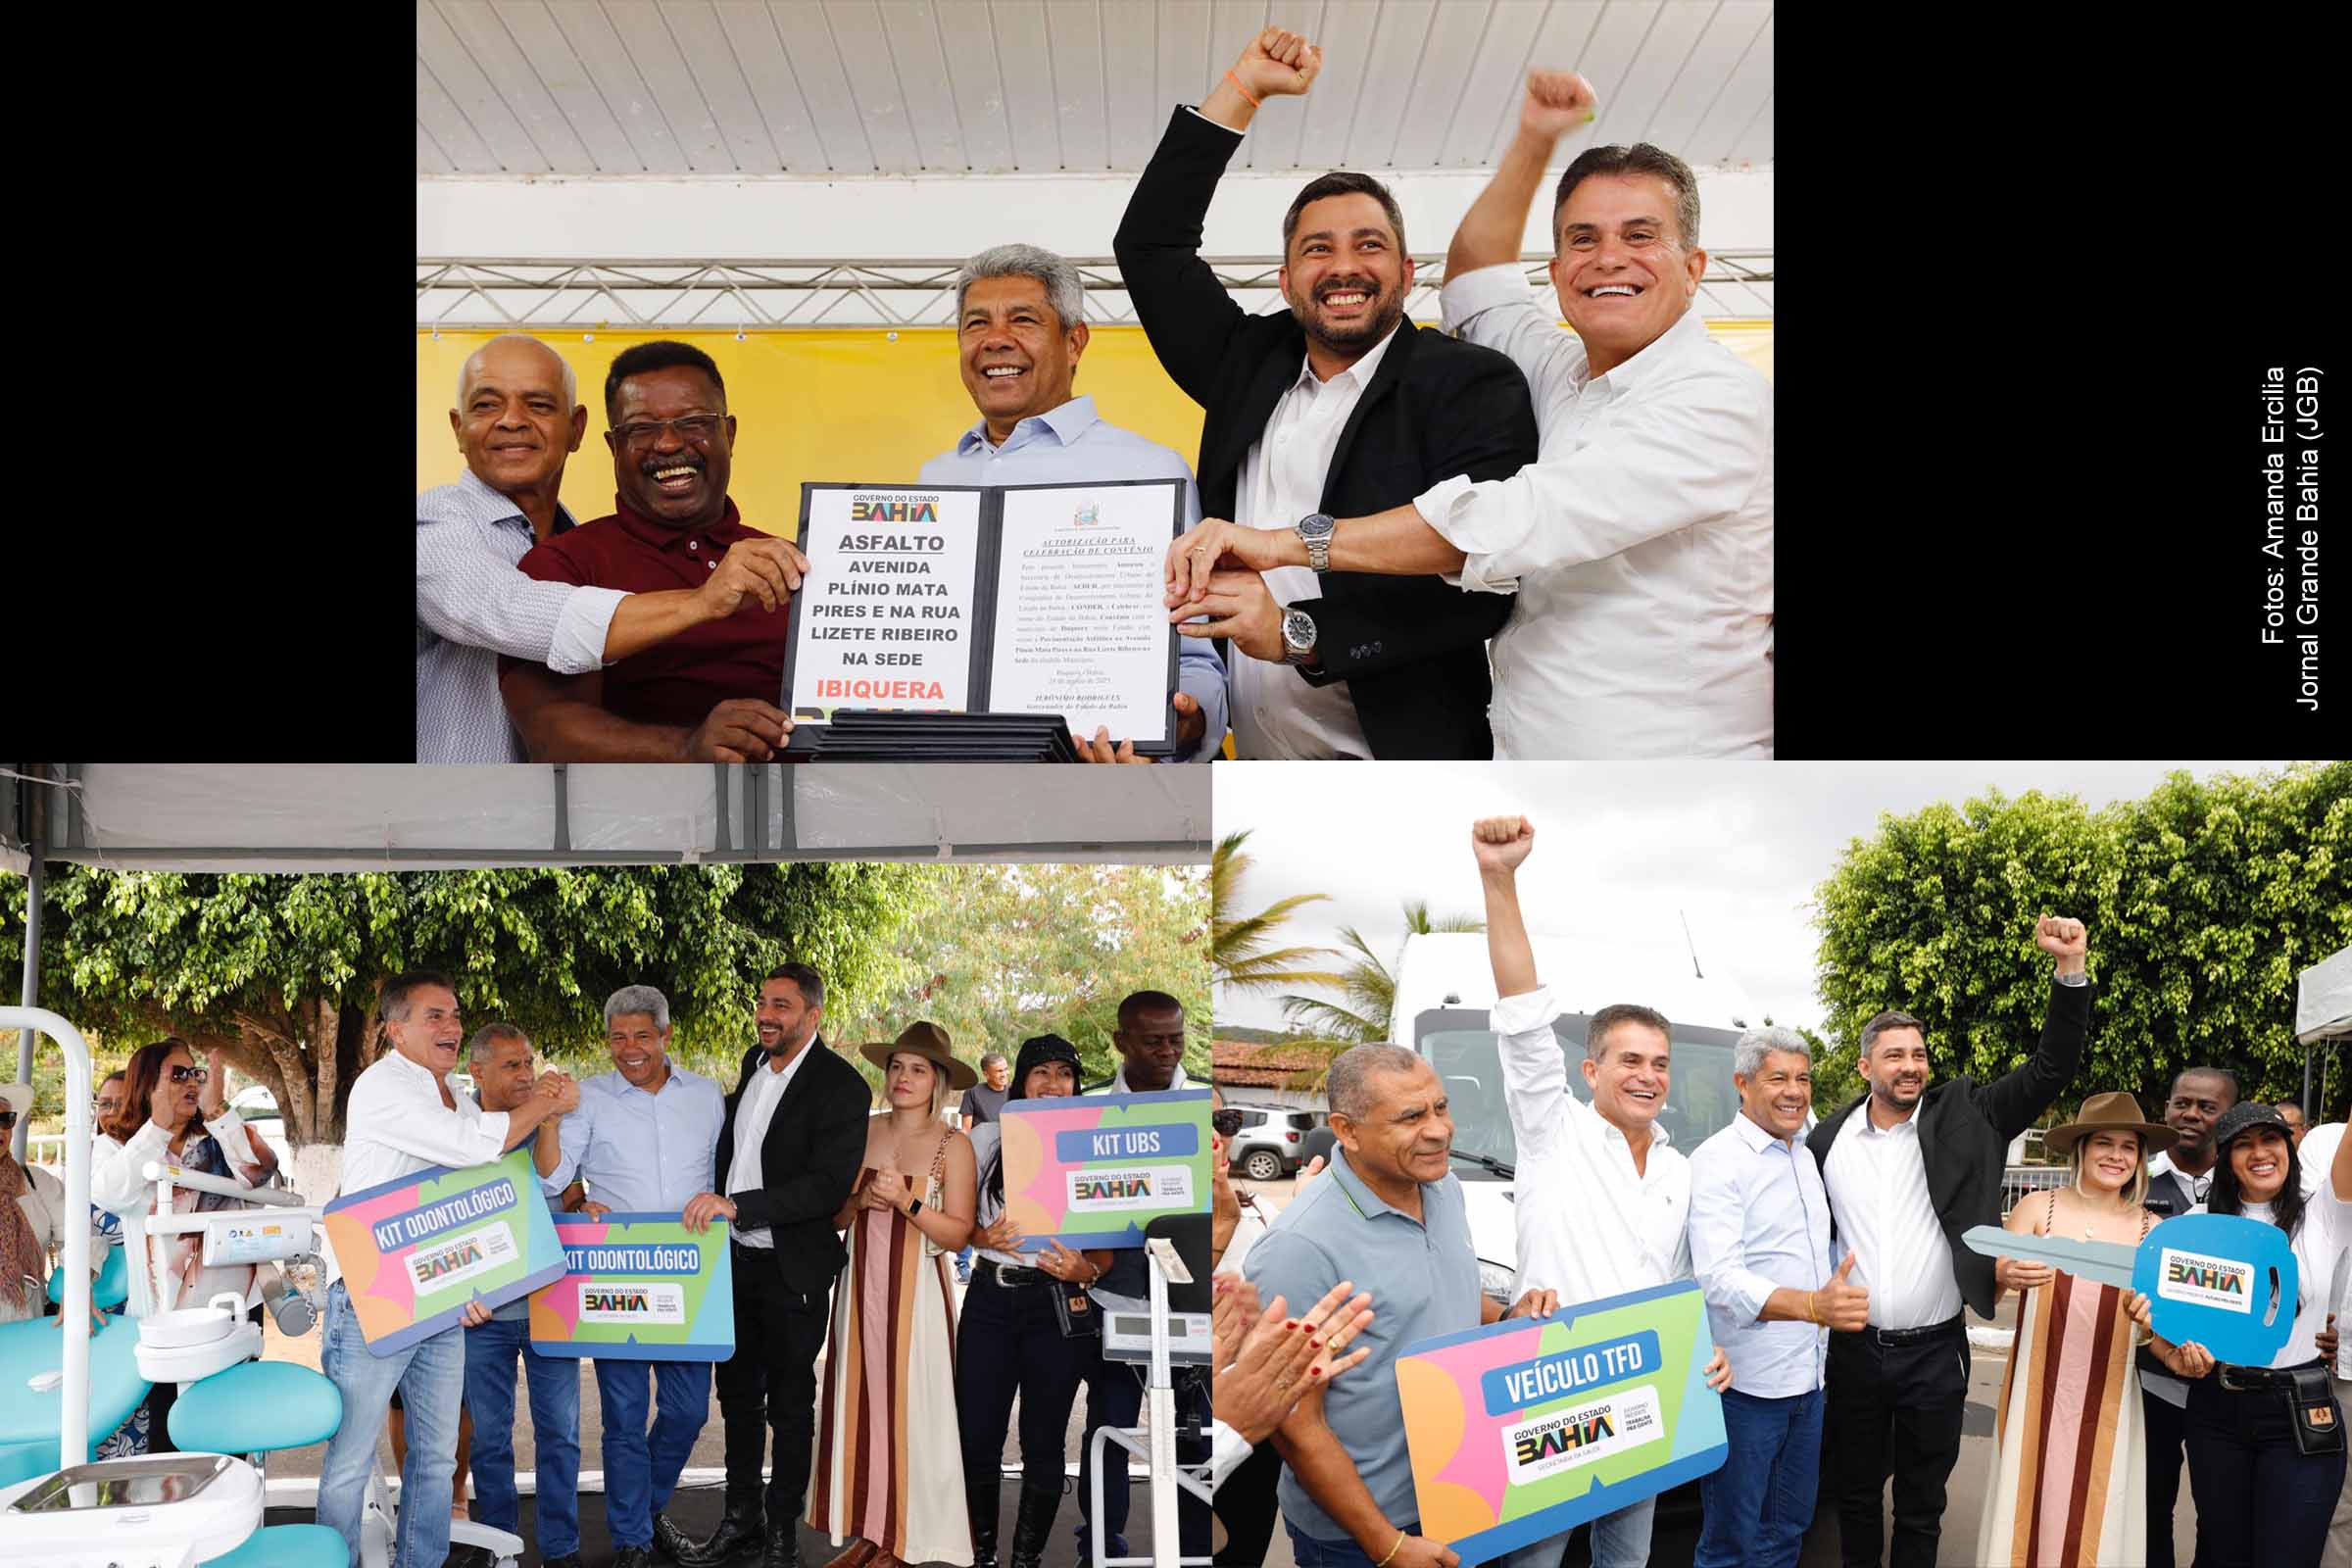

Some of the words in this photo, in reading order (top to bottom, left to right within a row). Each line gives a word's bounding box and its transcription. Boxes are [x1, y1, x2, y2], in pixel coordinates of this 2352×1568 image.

[853, 494, 893, 503] GOVERNO
[895, 494, 907, 503] DO
[839, 534, 945, 551] ASFALTO
[849, 561, 931, 574] AVENIDA
[828, 580, 890, 596] PLÍNIO
[896, 583, 949, 596] MATA
[812, 605, 866, 617] PIRES
[872, 606, 884, 617] E
[890, 606, 915, 618] NA
[922, 607, 960, 618] RUA
[811, 627, 876, 640] LIZETE
[882, 628, 957, 641] RIBEIRO
[843, 652, 868, 665] NA
[875, 653, 923, 666] SEDE
[816, 679, 944, 700] IBIQUERA
[1093, 1133, 1121, 1156] KIT
[1126, 1131, 1161, 1153] UBS
[375, 1221, 404, 1250] KIT
[405, 1182, 515, 1239] ODONTOLÓGICO
[564, 1250, 585, 1270] KIT
[588, 1246, 699, 1271] ODONTOLÓGICO
[2170, 1255, 2205, 1268] GOVERNO
[2207, 1262, 2218, 1271] DO
[2219, 1264, 2245, 1275] ESTADO
[1504, 1351, 1599, 1403] VEÍCULO
[1602, 1342, 1643, 1378] TFD
[1513, 1419, 1561, 1442] GOVERNO
[1562, 1415, 1577, 1427] DO
[1578, 1404, 1612, 1421] ESTADO
